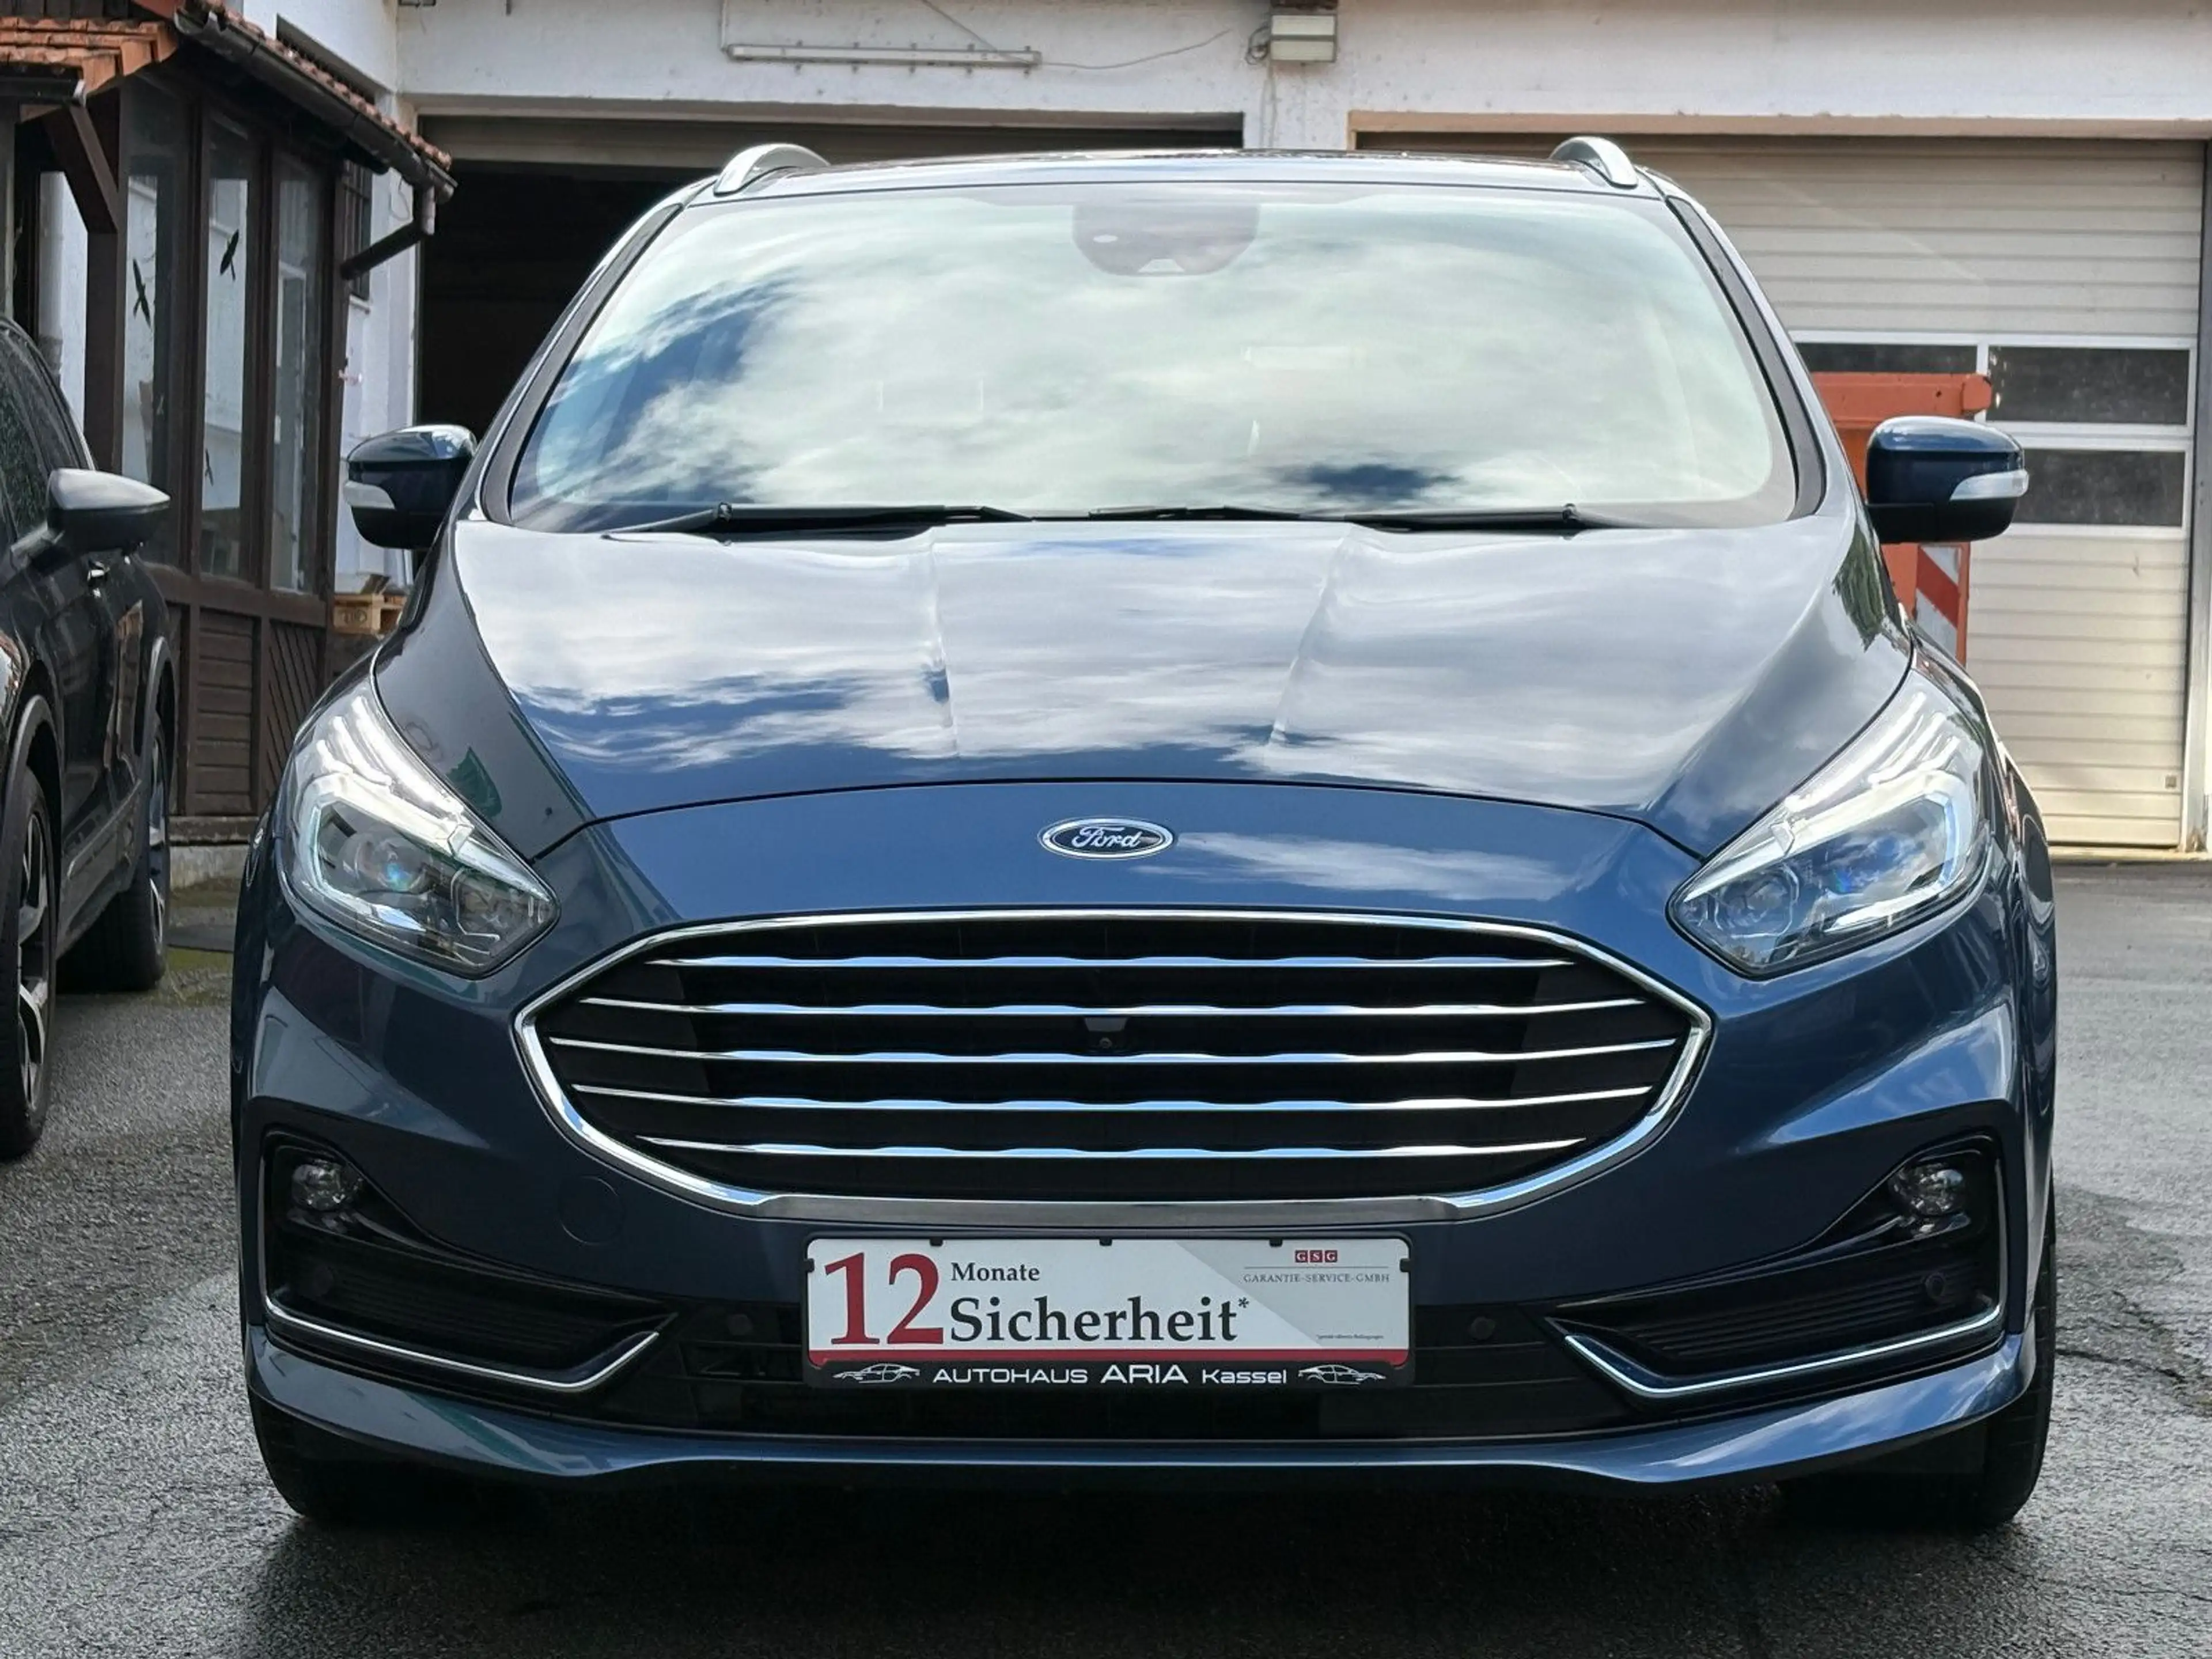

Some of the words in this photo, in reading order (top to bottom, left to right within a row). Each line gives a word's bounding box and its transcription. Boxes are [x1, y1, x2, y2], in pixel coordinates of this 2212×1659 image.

[1071, 825, 1142, 848] Ford
[1296, 1251, 1337, 1262] GSG
[951, 1262, 1040, 1281] Monate
[824, 1252, 944, 1344] 12
[933, 1368, 1088, 1384] AUTOHAUS
[1100, 1364, 1189, 1384] ARIA
[1202, 1369, 1287, 1384] Kassel
